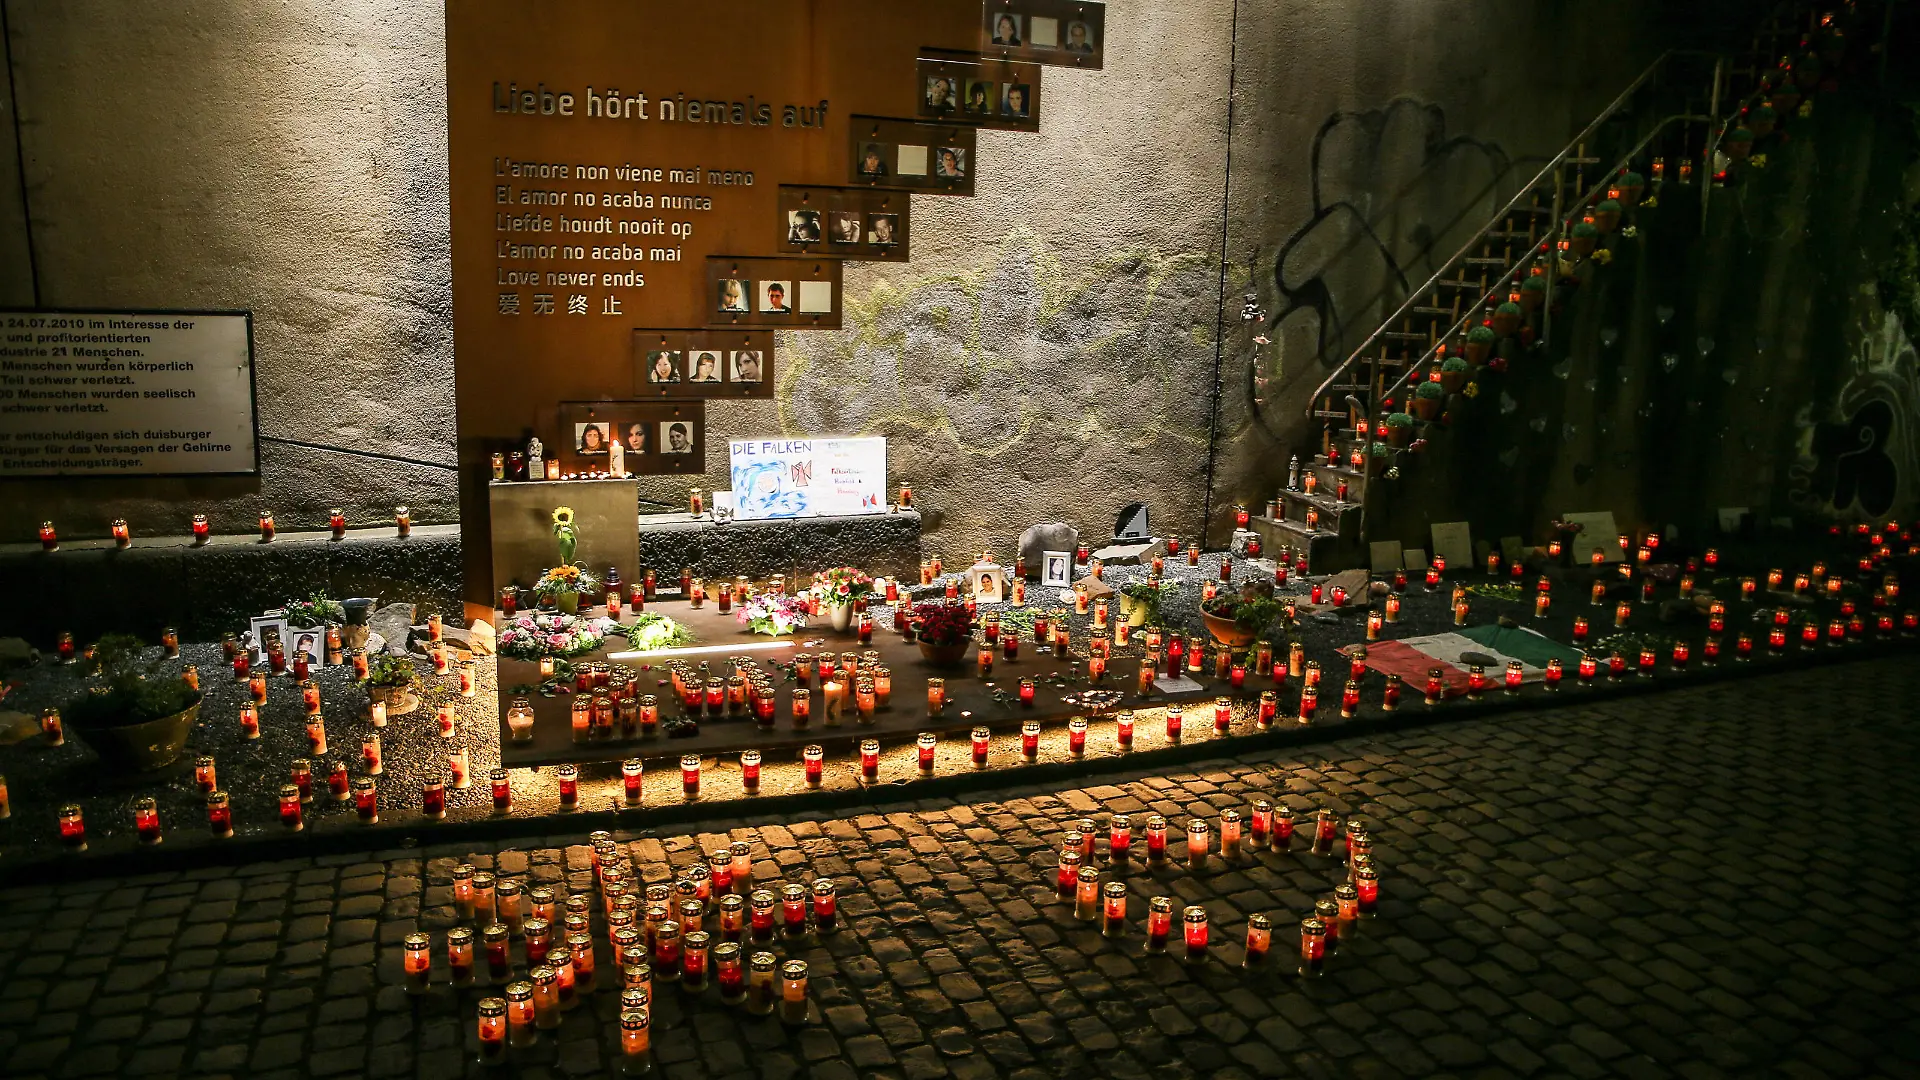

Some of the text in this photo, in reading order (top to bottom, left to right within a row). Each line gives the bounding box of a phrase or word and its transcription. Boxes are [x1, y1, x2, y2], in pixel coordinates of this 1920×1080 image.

[493, 81, 829, 130] Liebe hört niemals auf
[495, 157, 755, 186] L'amore non viene mai meno
[496, 185, 713, 211] El amor no acaba nunca
[496, 213, 693, 240] Liefde houdt nooit op
[496, 240, 682, 262] L'amor no acaba mai
[498, 268, 645, 287] Love never ends
[498, 293, 623, 316] 爱无终止
[8, 319, 85, 329] 24.07.2010
[89, 319, 105, 329] im
[109, 320, 170, 330] Interesse
[174, 320, 195, 330] der
[7, 333, 151, 345] und profitorientierten
[52, 347, 67, 357] 21
[73, 348, 145, 357] Menschen.
[2, 361, 194, 374] Menschen wurden körperlich
[0, 375, 135, 385] Teil schwer verletzt.
[18, 389, 87, 399] Menschen
[91, 389, 139, 399] wurden
[144, 389, 196, 399] seelisch
[2, 403, 108, 413] schwer verletzt.
[15, 430, 109, 443] entschuldigen
[113, 430, 139, 440] sich
[143, 430, 212, 442] duisburger
[45, 444, 64, 454] für
[68, 444, 91, 454] das
[95, 444, 154, 456] Versagen
[158, 443, 179, 453] der
[182, 443, 232, 453] Gehirne
[733, 442, 756, 456] DIE
[763, 440, 812, 454] FALKEN
[3, 458, 143, 470] Entscheidungsträger.
